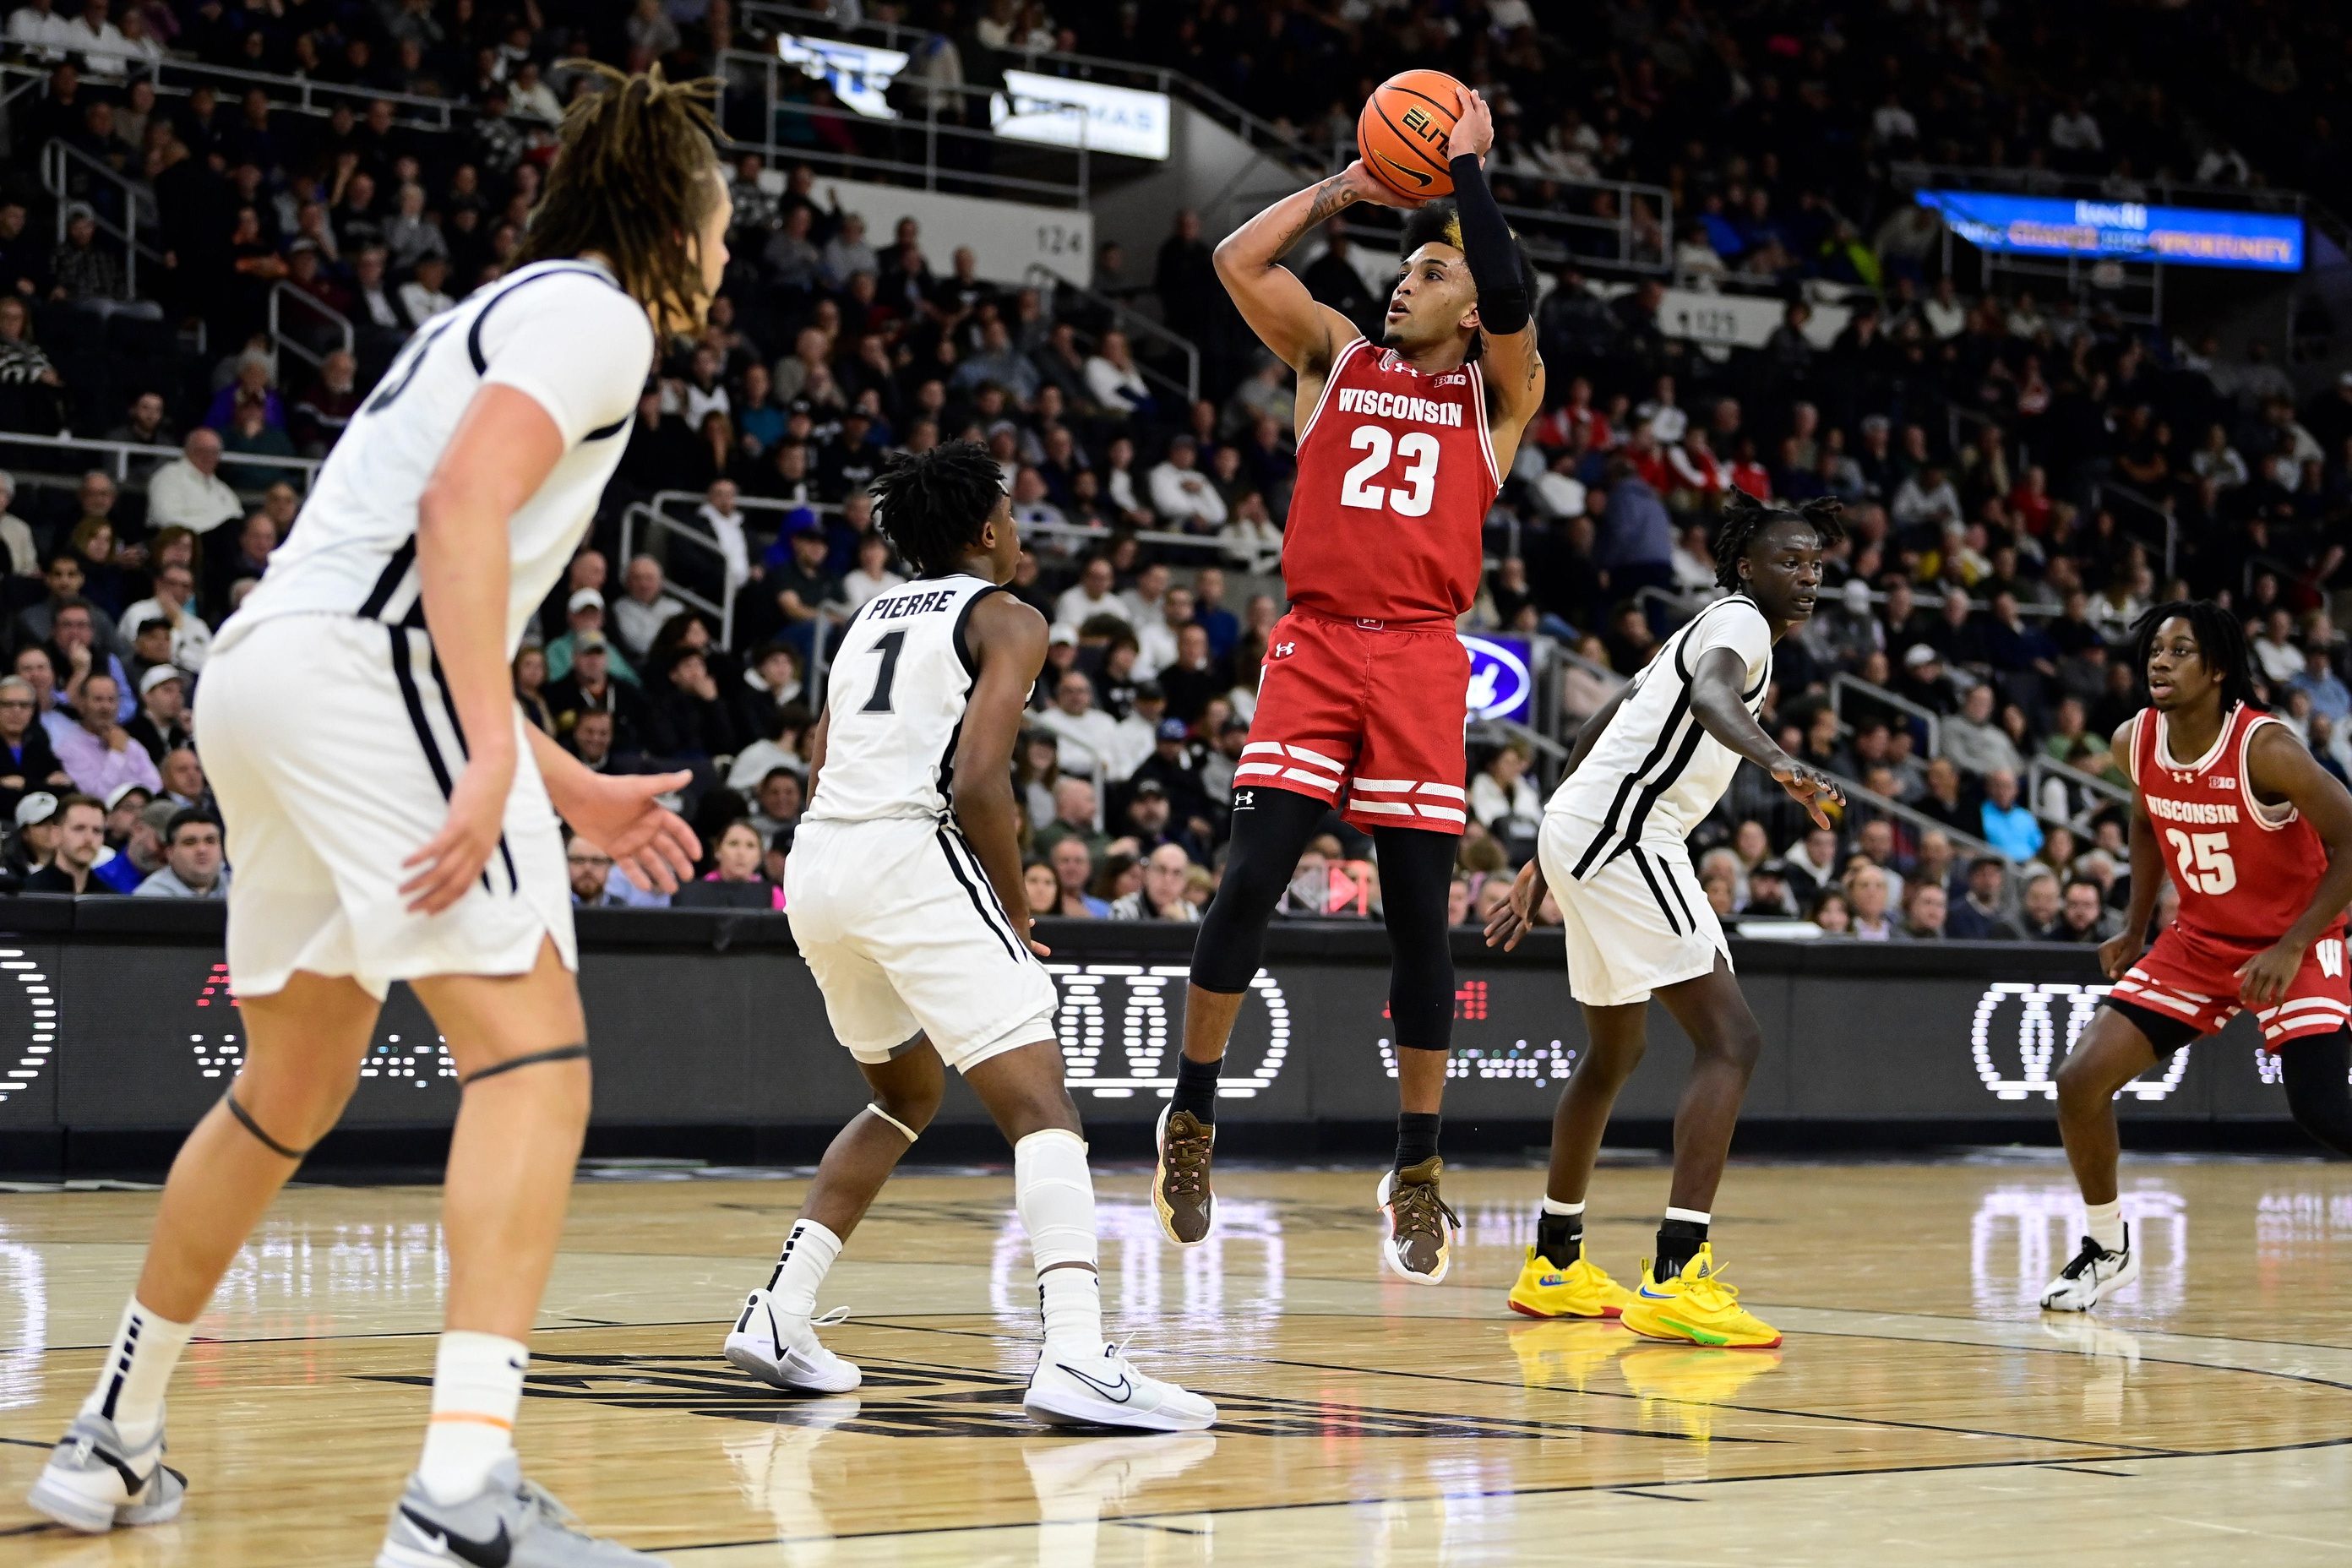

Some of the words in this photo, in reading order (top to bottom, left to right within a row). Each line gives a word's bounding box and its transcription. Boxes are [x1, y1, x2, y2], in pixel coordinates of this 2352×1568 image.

[1036, 225, 1083, 254] 124
[1338, 388, 1462, 427] WISCONSIN
[1340, 425, 1440, 517] 23
[866, 591, 957, 621] PIERRE
[857, 627, 909, 715] 1
[2145, 793, 2240, 825] WISCONSIN
[2165, 827, 2237, 896] 25
